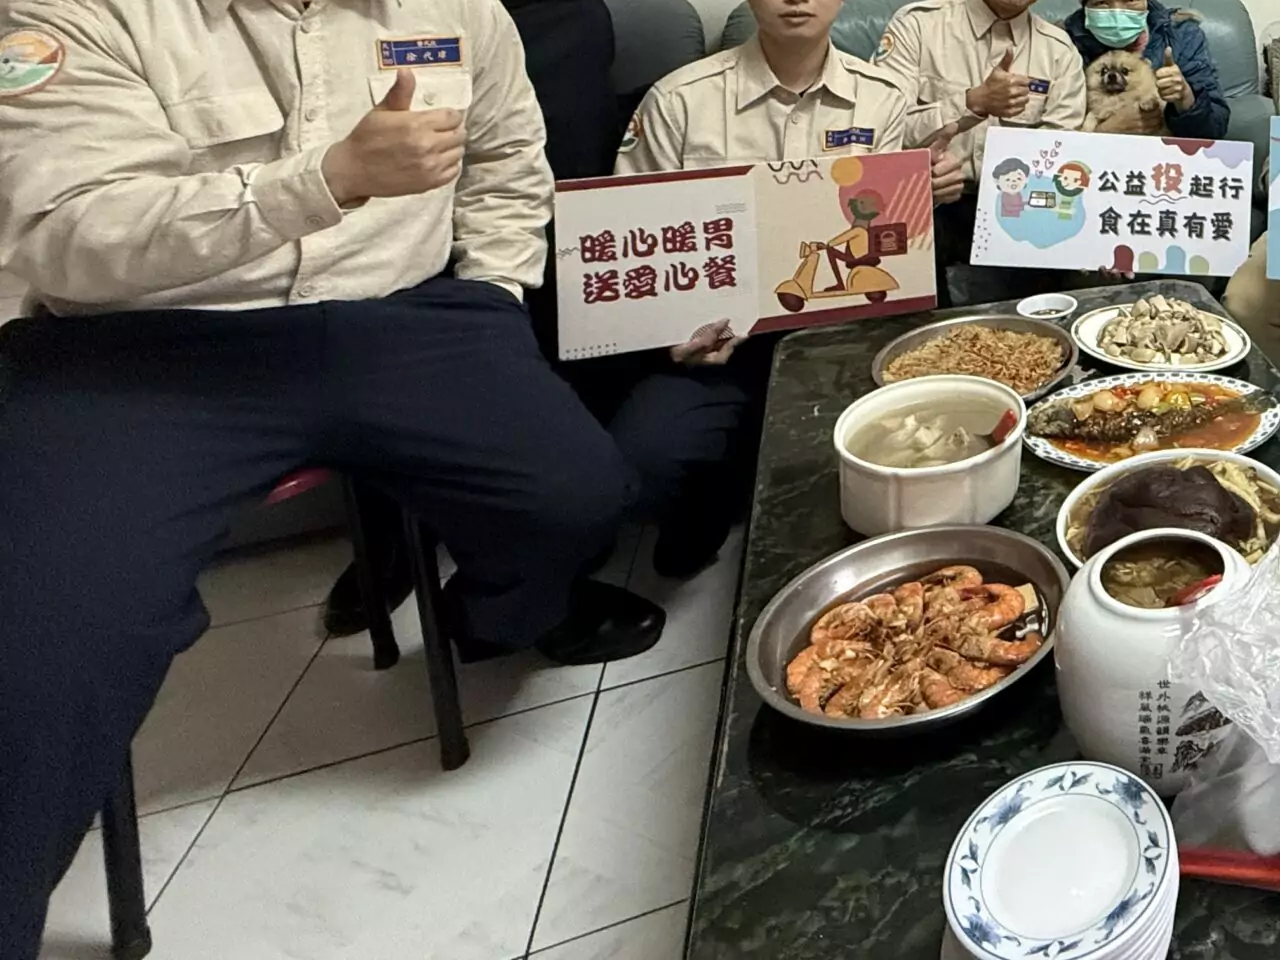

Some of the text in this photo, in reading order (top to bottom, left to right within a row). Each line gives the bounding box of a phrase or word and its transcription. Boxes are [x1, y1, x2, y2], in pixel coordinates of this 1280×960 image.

[1097, 162, 1245, 200] 公益役起行
[578, 217, 735, 265] 暖心暖胃
[1098, 206, 1235, 242] 食在真有愛
[582, 255, 739, 305] 送愛心餐
